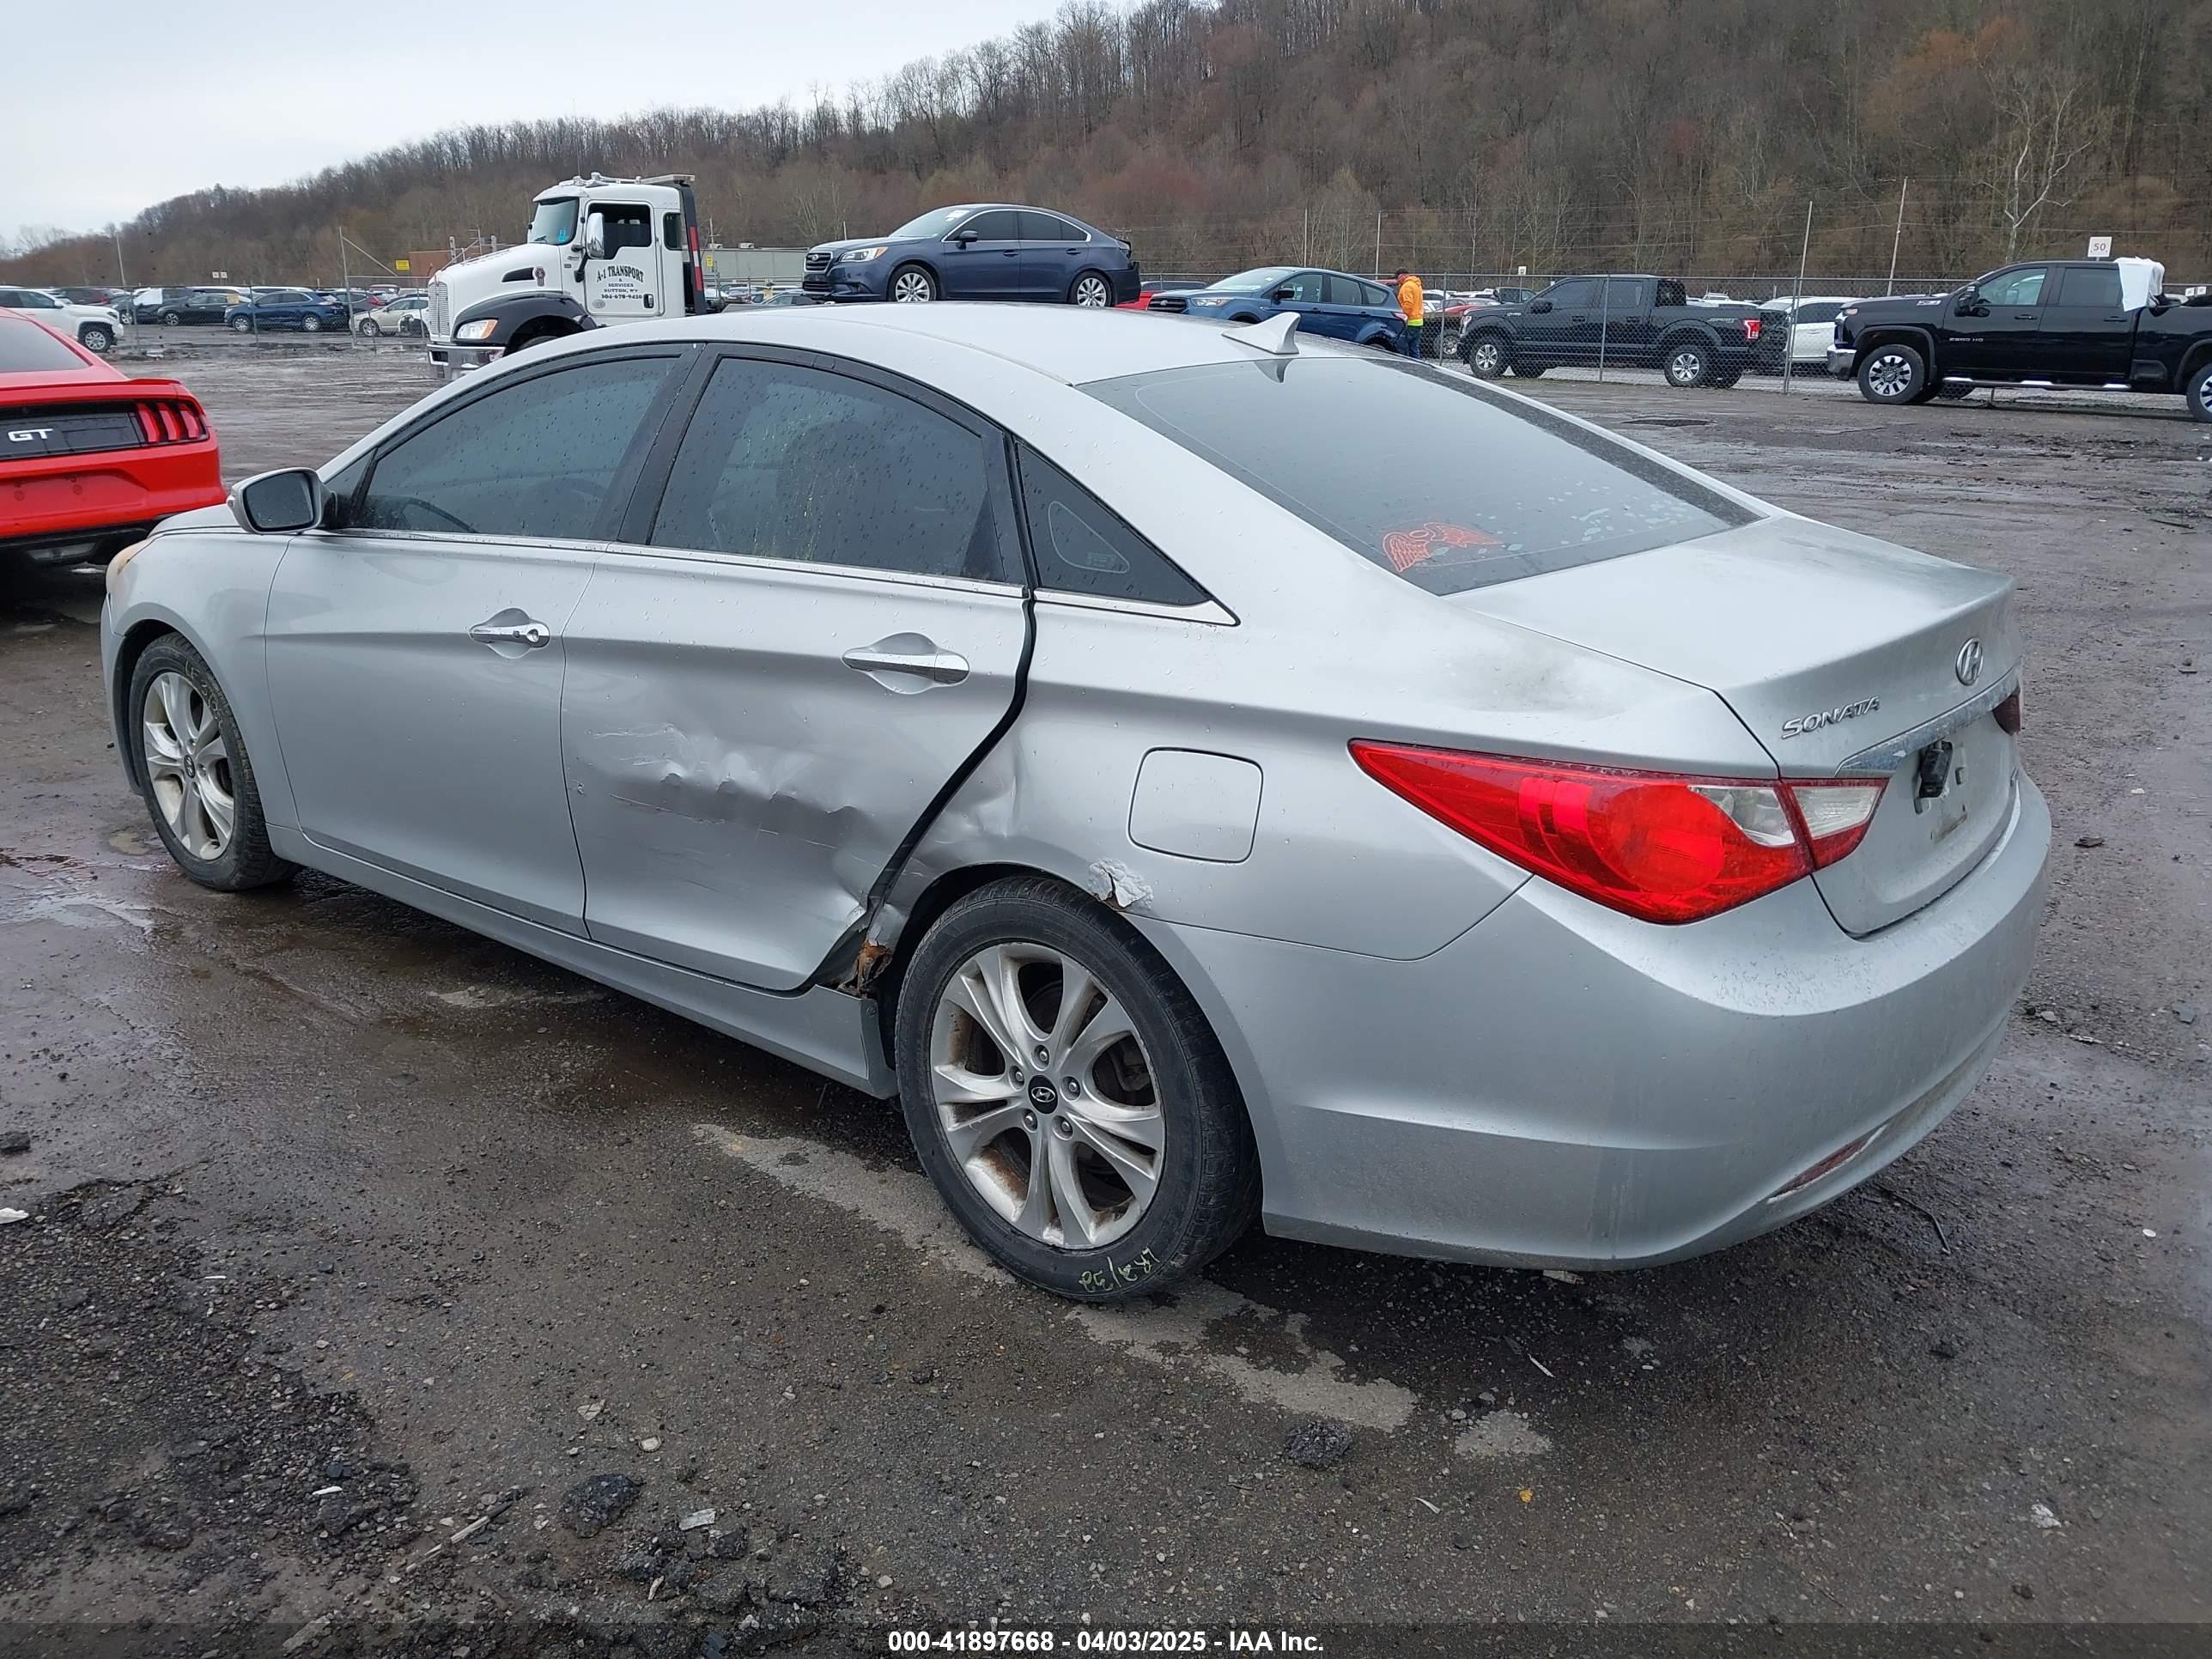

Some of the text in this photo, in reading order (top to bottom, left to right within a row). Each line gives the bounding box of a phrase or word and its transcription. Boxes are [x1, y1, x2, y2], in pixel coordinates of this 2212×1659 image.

[2093, 242, 2106, 252] 50
[596, 264, 644, 283] A-1 TRANSPORT
[7, 428, 53, 442] GT
[1781, 696, 1880, 739] SONATA
